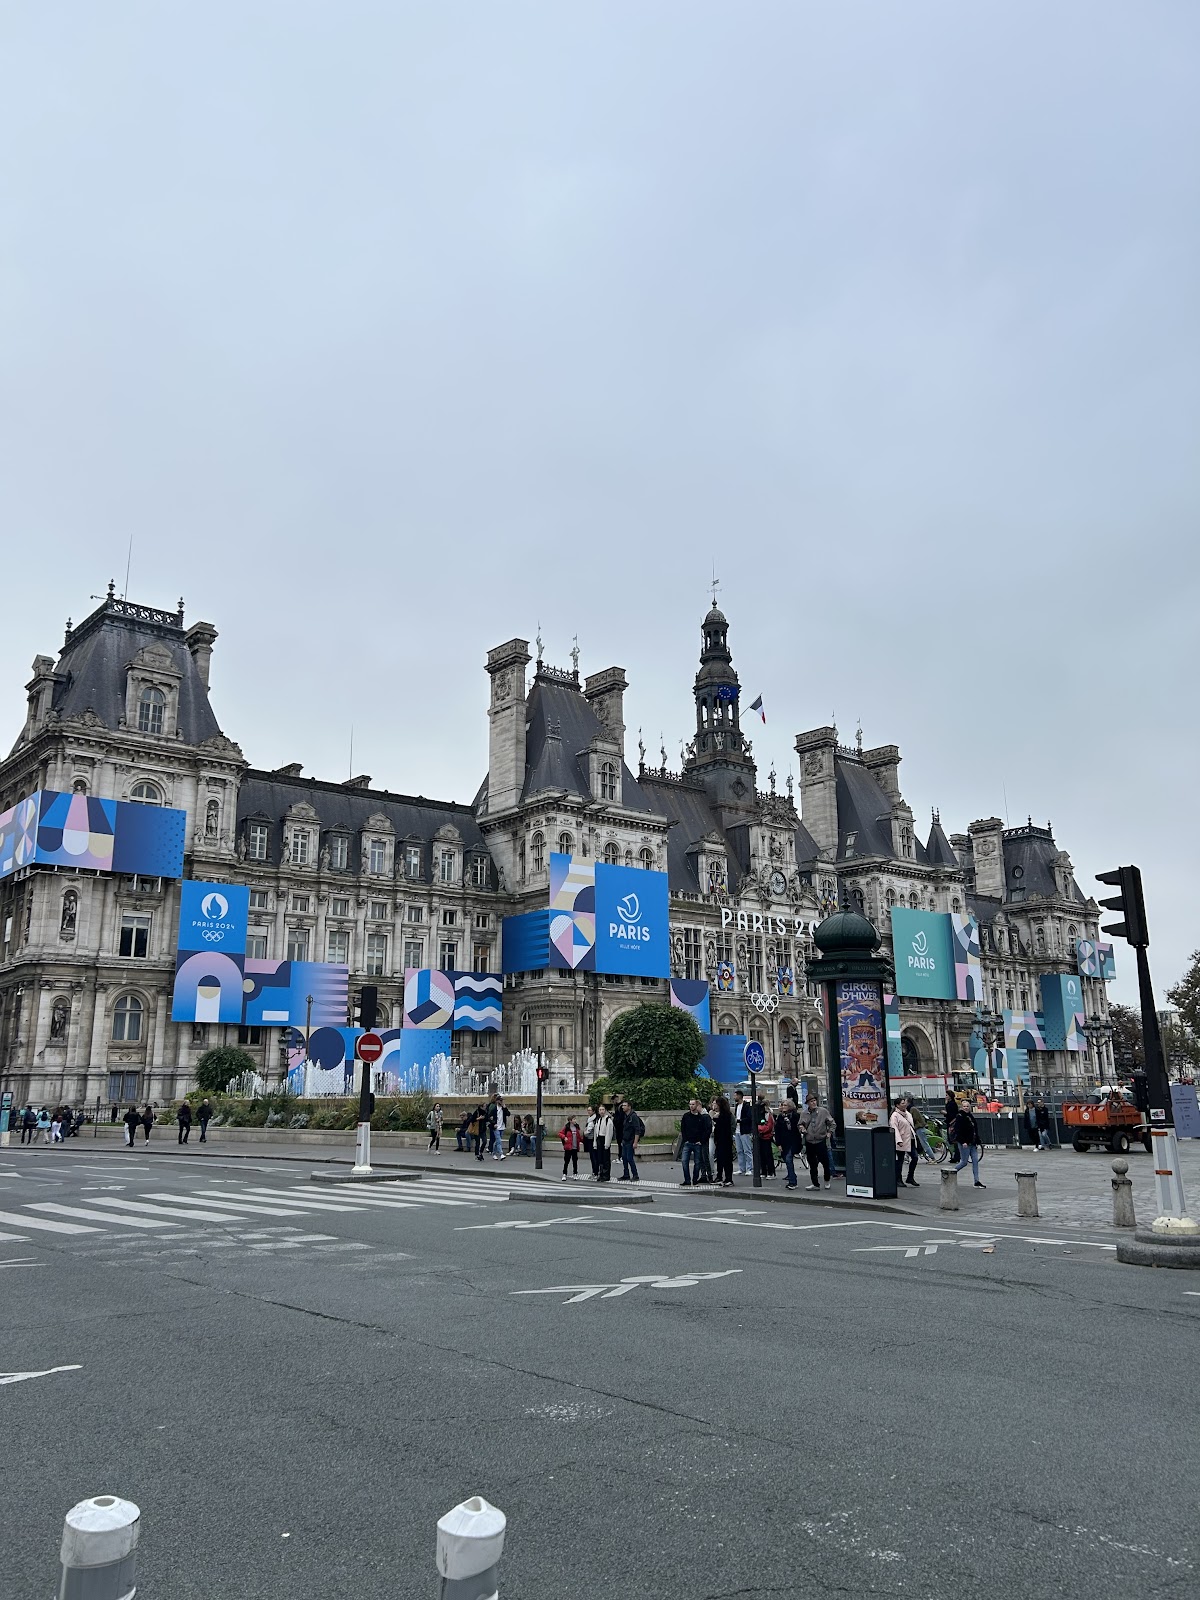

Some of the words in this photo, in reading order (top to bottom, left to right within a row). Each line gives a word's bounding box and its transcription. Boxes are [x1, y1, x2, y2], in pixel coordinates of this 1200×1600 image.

[192, 920, 214, 928] PARIS
[215, 922, 235, 930] 2024
[721, 907, 787, 936] PARIS
[609, 922, 651, 942] PARIS
[908, 955, 936, 970] PARIS
[841, 982, 878, 992] CIRQUE
[841, 991, 878, 1001] D'HIVER
